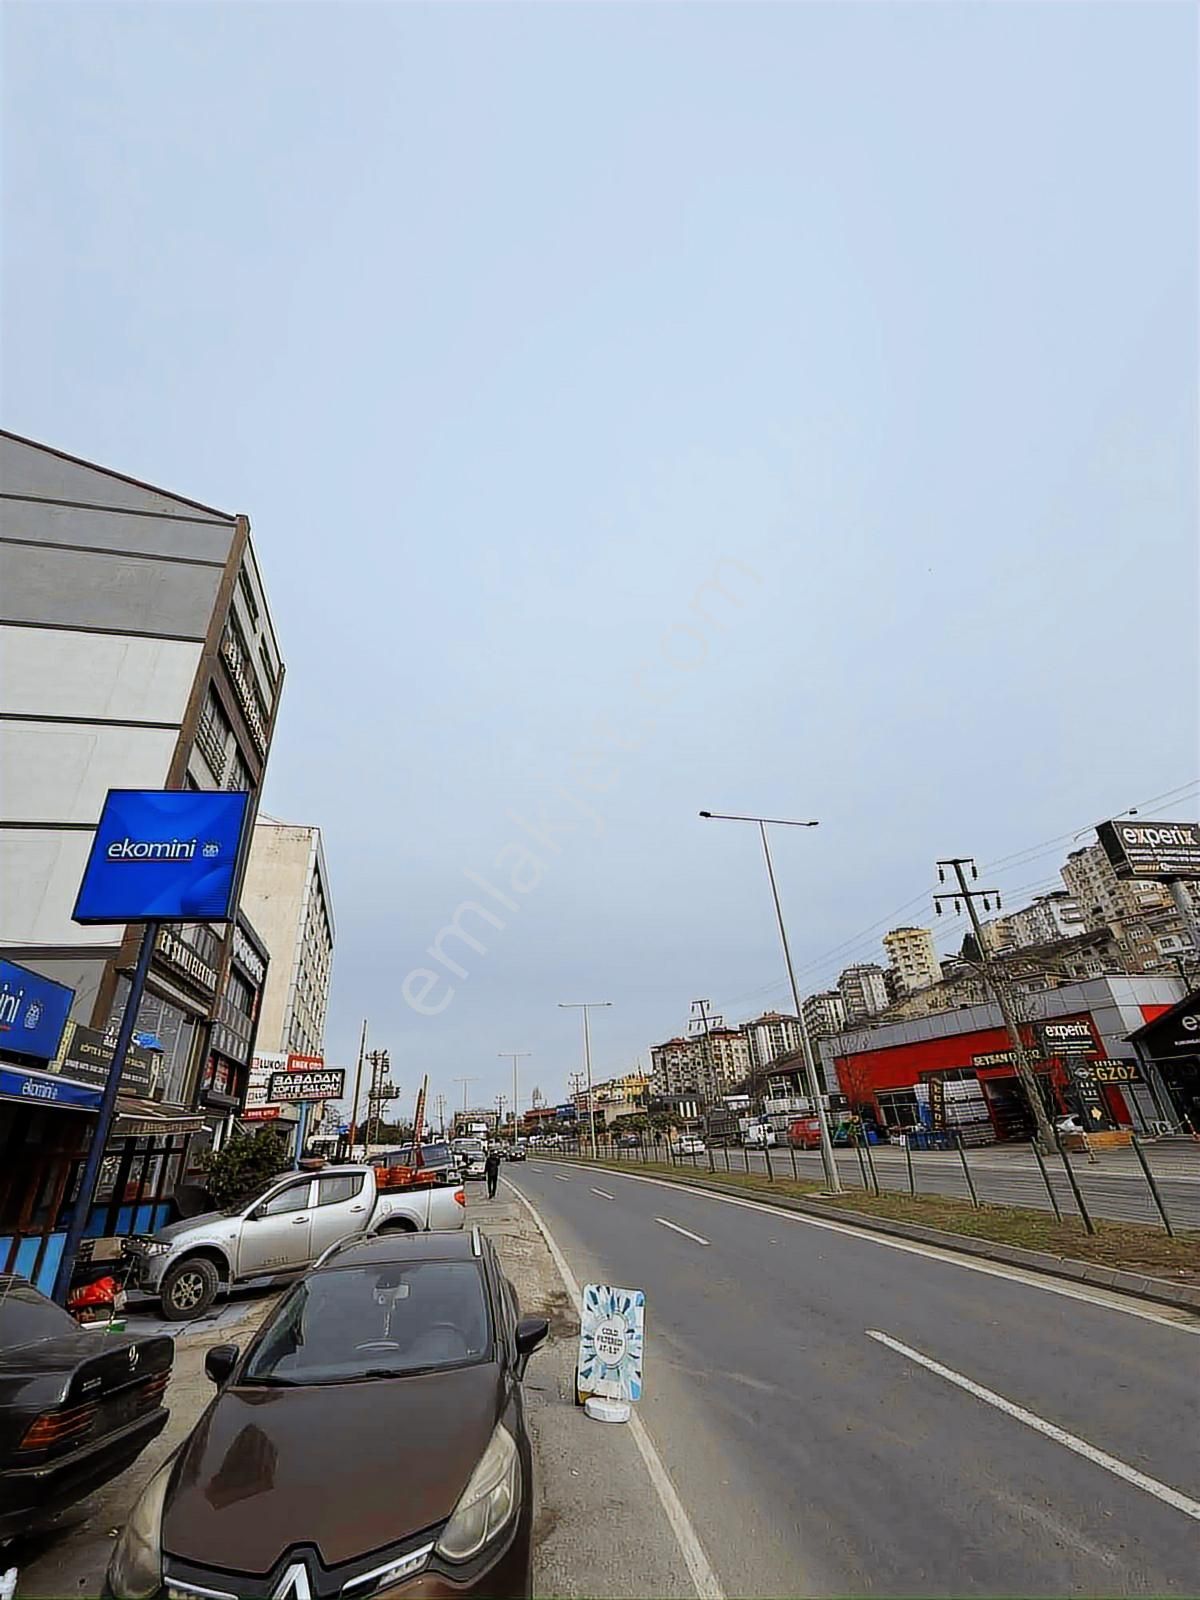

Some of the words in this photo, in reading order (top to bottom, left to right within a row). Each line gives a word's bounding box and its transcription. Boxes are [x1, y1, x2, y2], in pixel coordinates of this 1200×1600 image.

[1122, 825, 1197, 847] experix
[108, 838, 197, 858] ekomini
[1045, 1021, 1091, 1040] experix
[274, 1073, 340, 1086] BABADAN
[1089, 1066, 1139, 1081] EGZOZ
